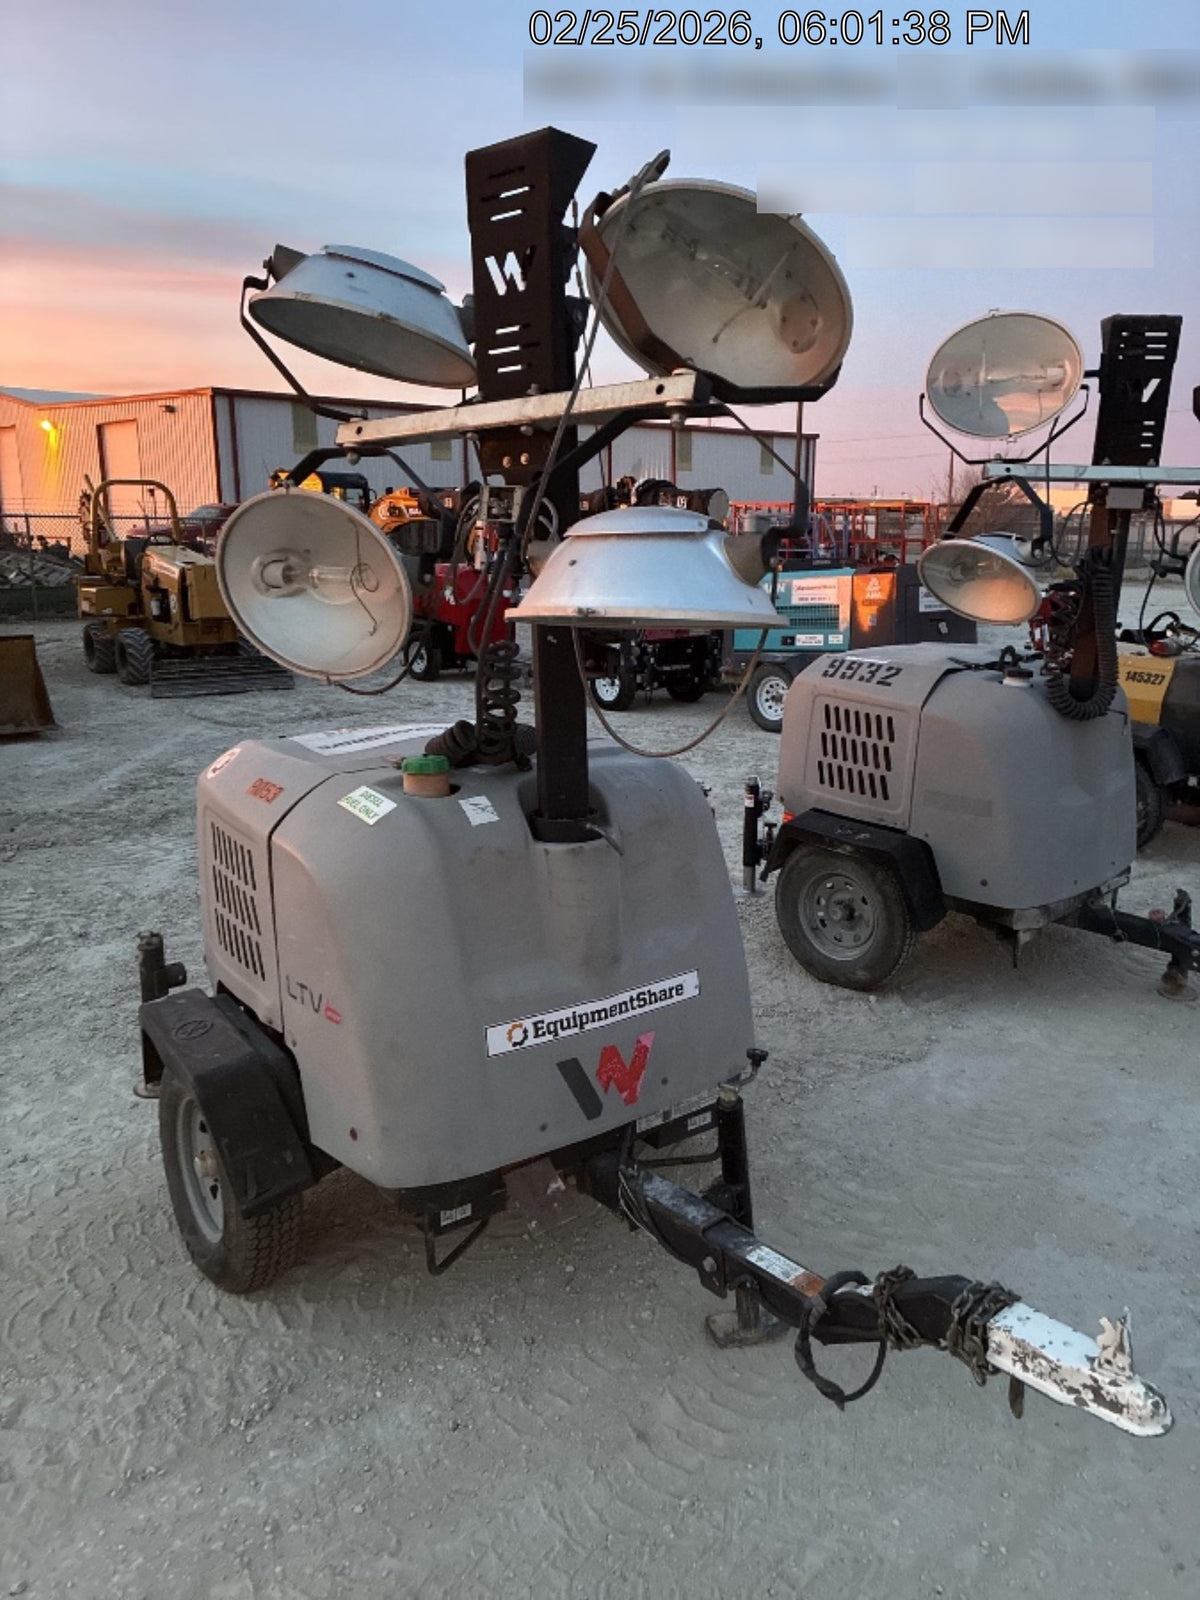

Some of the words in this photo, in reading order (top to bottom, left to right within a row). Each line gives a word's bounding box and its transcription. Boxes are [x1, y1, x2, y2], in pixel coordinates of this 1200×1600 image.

[822, 659, 902, 687] 9932
[1126, 670, 1165, 685] 145327
[343, 796, 361, 809] FUEL
[359, 804, 379, 819] ONLY
[360, 790, 385, 807] DIESEL
[531, 982, 684, 1040] EquipmentShare
